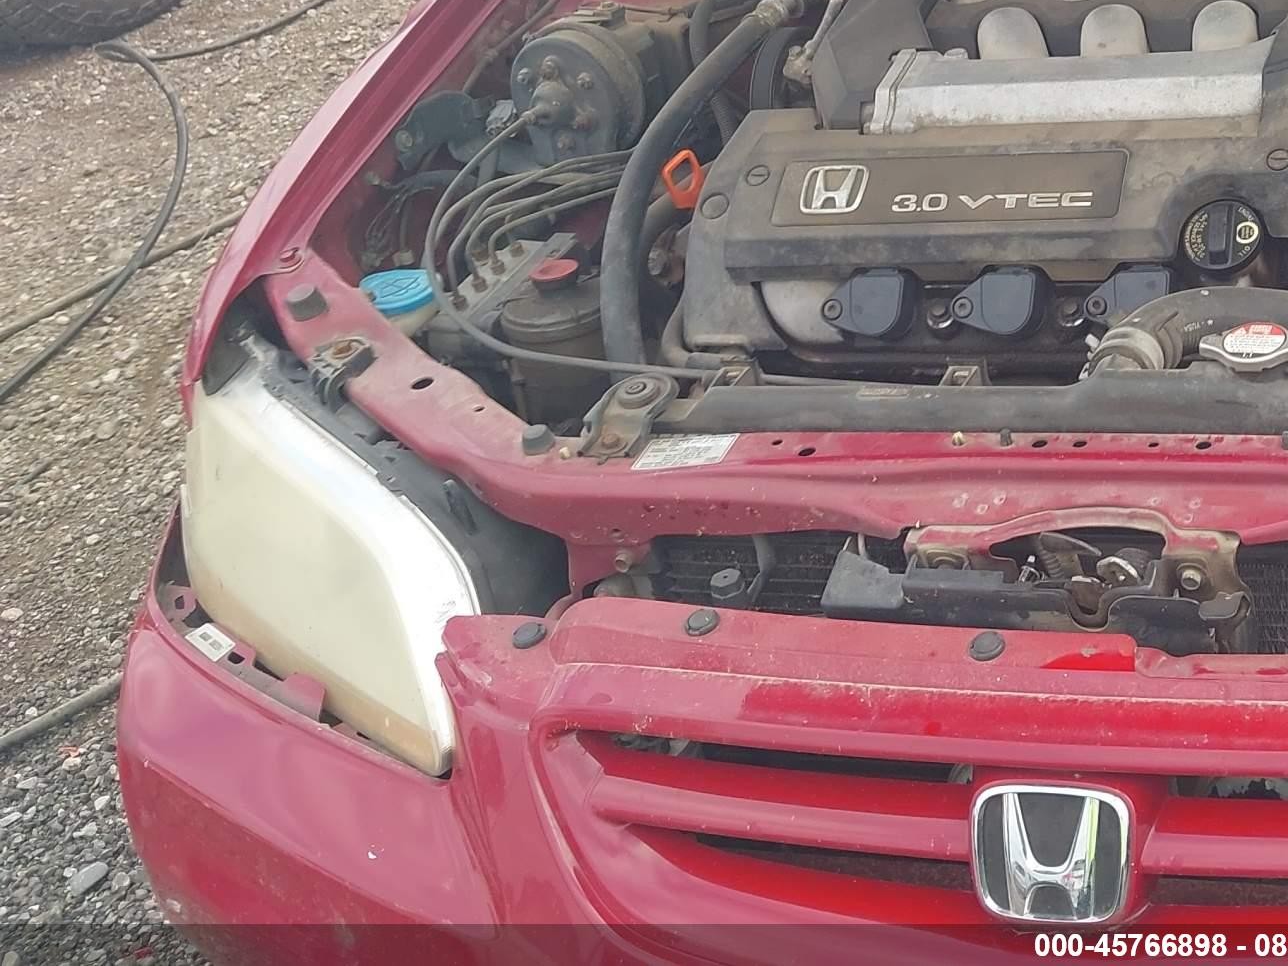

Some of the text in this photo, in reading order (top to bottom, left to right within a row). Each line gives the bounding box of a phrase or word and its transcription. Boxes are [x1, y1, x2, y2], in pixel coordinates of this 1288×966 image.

[892, 191, 1093, 213] 3.0 VTEC
[1238, 246, 1251, 258] OIL
